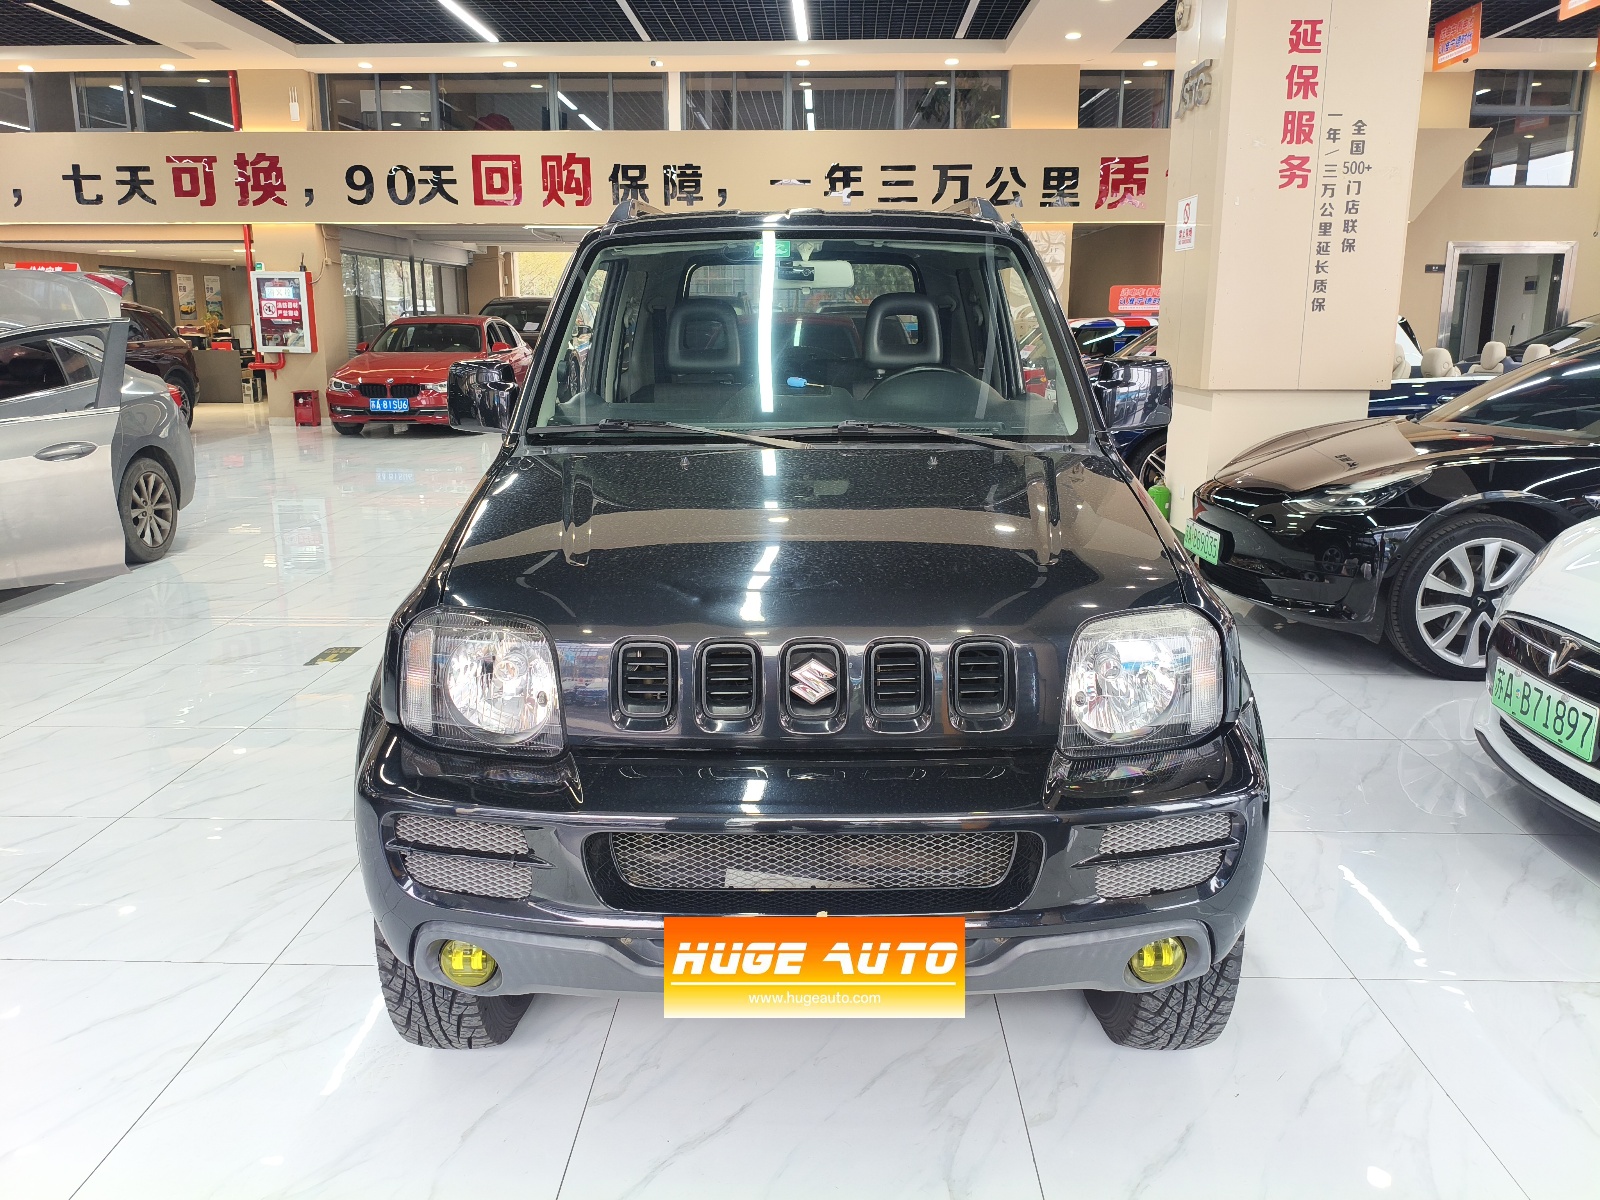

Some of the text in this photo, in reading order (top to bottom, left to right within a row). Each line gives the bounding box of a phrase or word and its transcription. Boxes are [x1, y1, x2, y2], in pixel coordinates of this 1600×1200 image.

[1278, 19, 1324, 189] 延保服务
[1341, 119, 1373, 253] 全国500+门店联保
[1311, 113, 1343, 312] 一年/三万公里延长质保
